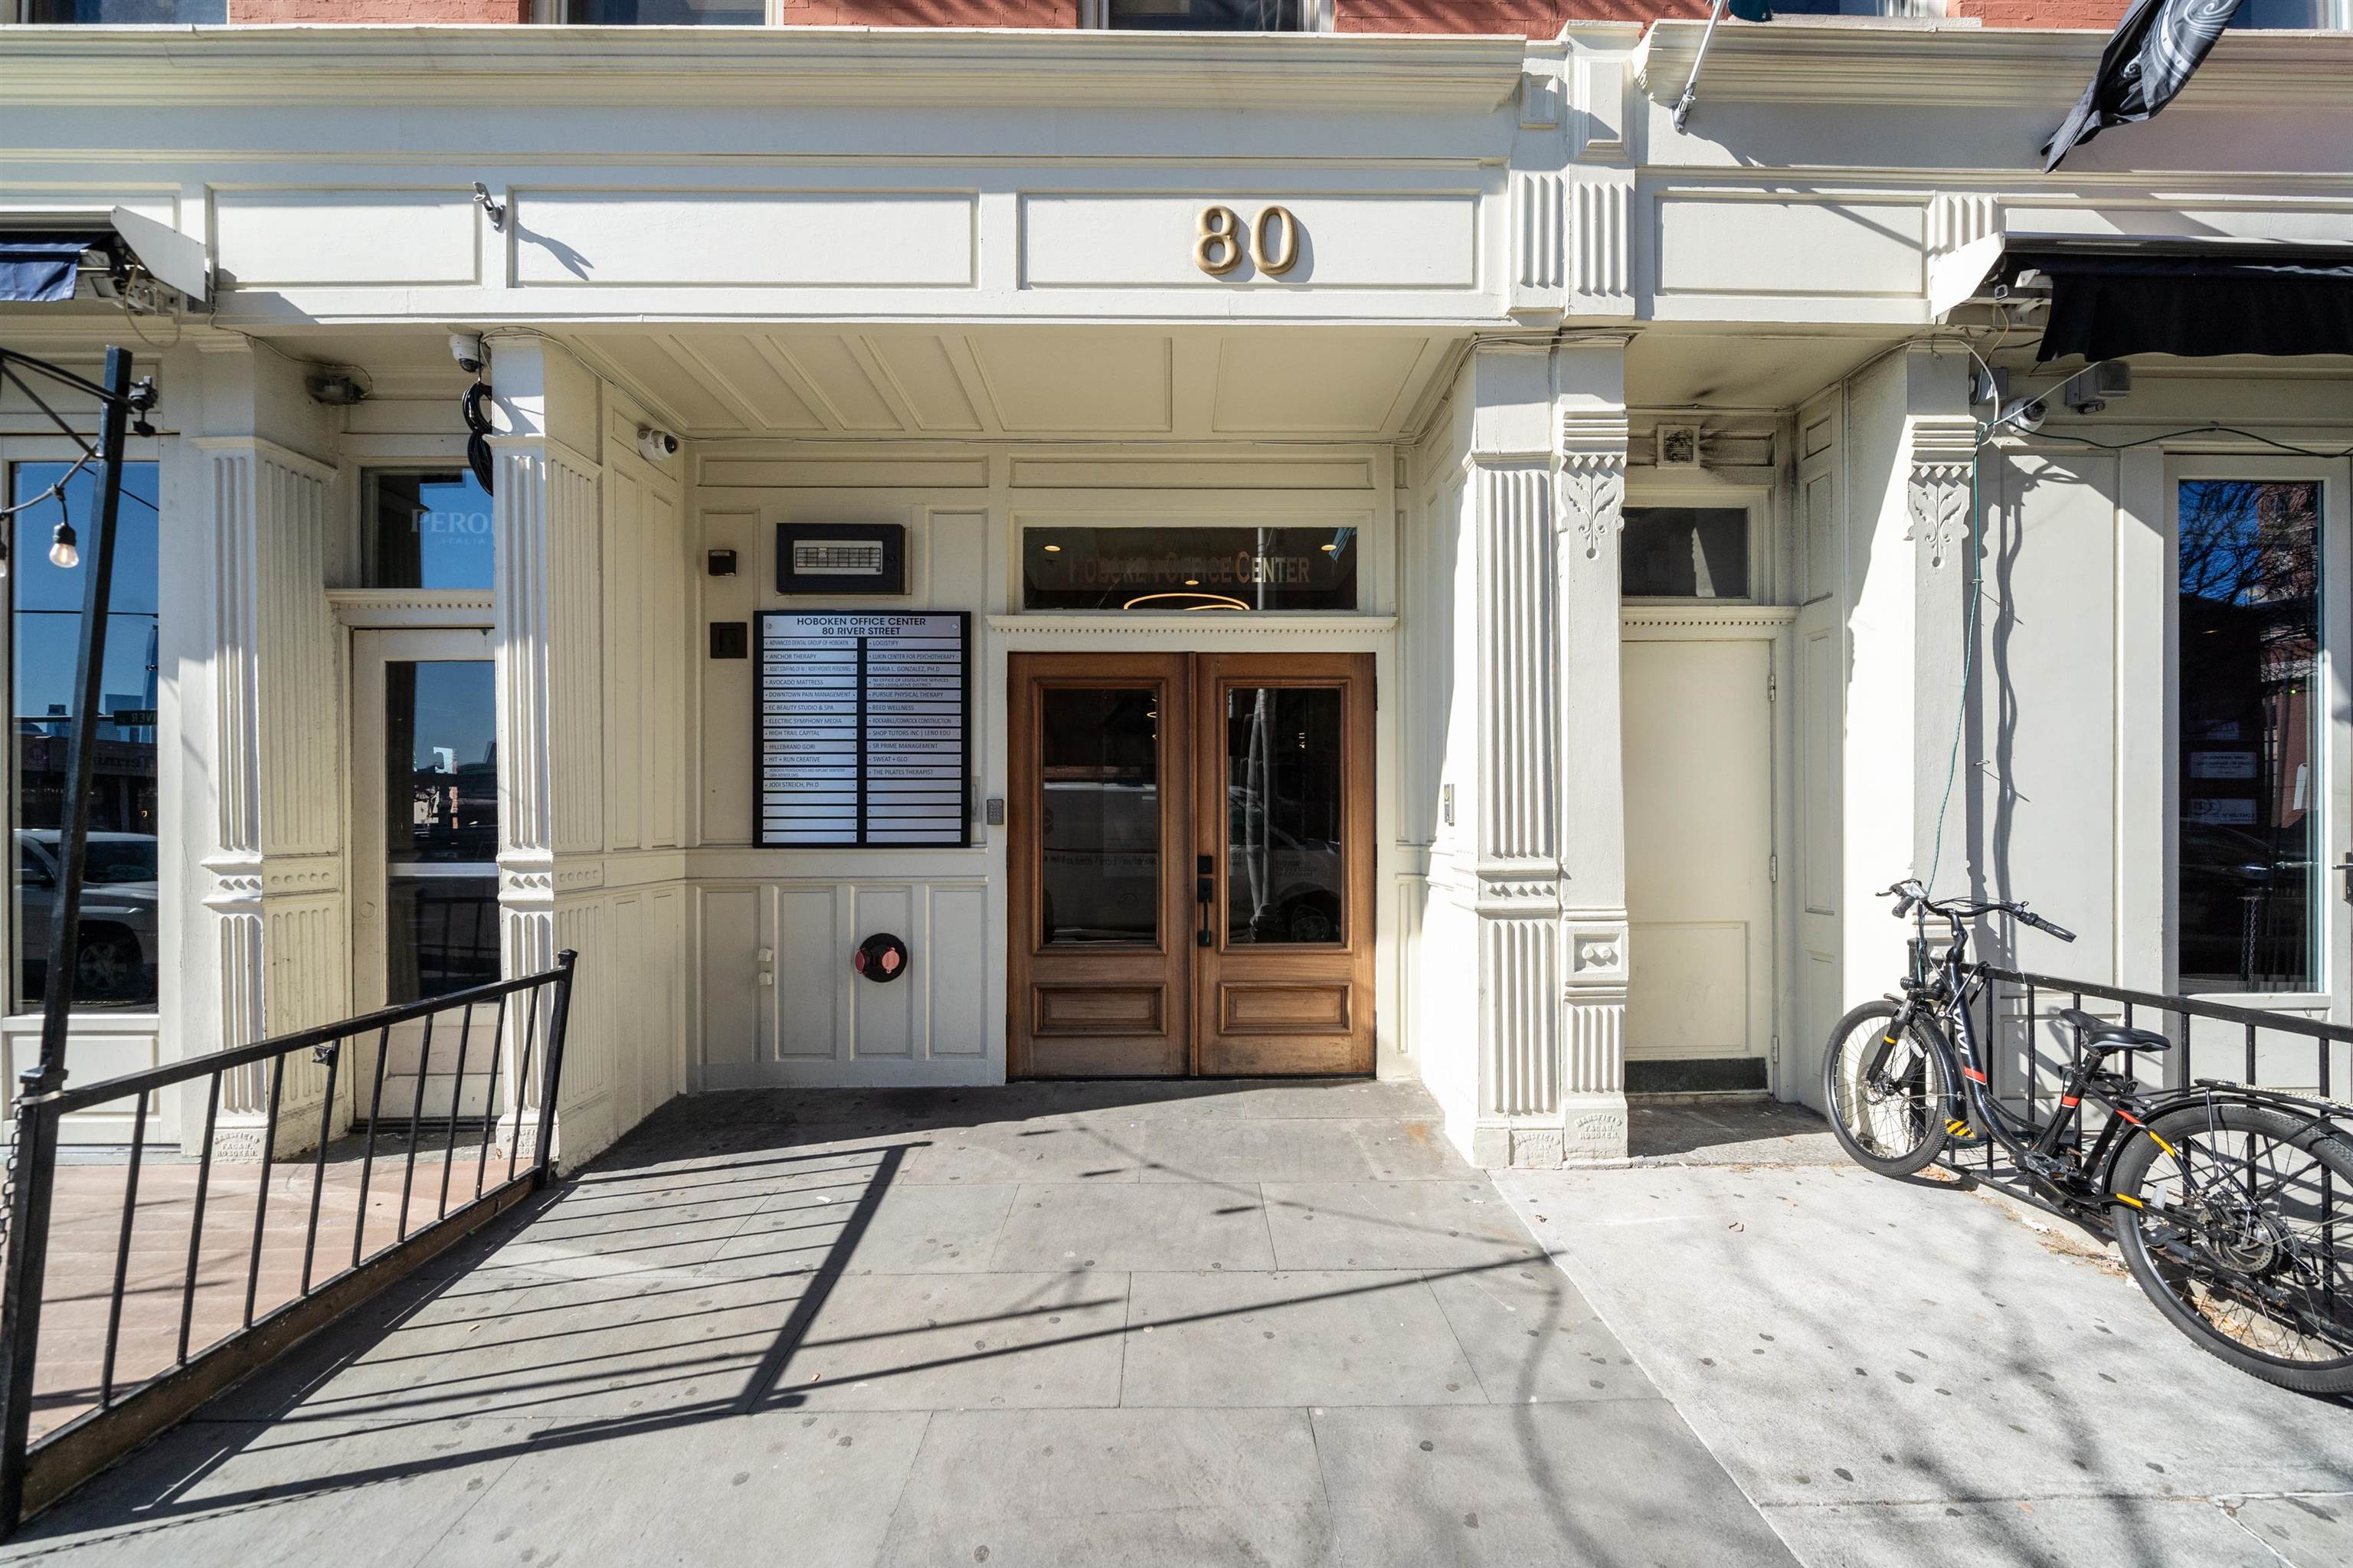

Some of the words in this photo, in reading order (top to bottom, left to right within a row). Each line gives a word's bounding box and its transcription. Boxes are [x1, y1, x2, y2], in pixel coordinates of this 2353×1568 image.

[1193, 205, 1299, 275] 80
[1236, 551, 1311, 584] CENTER
[1575, 1114, 1622, 1128] MANSFIELD
